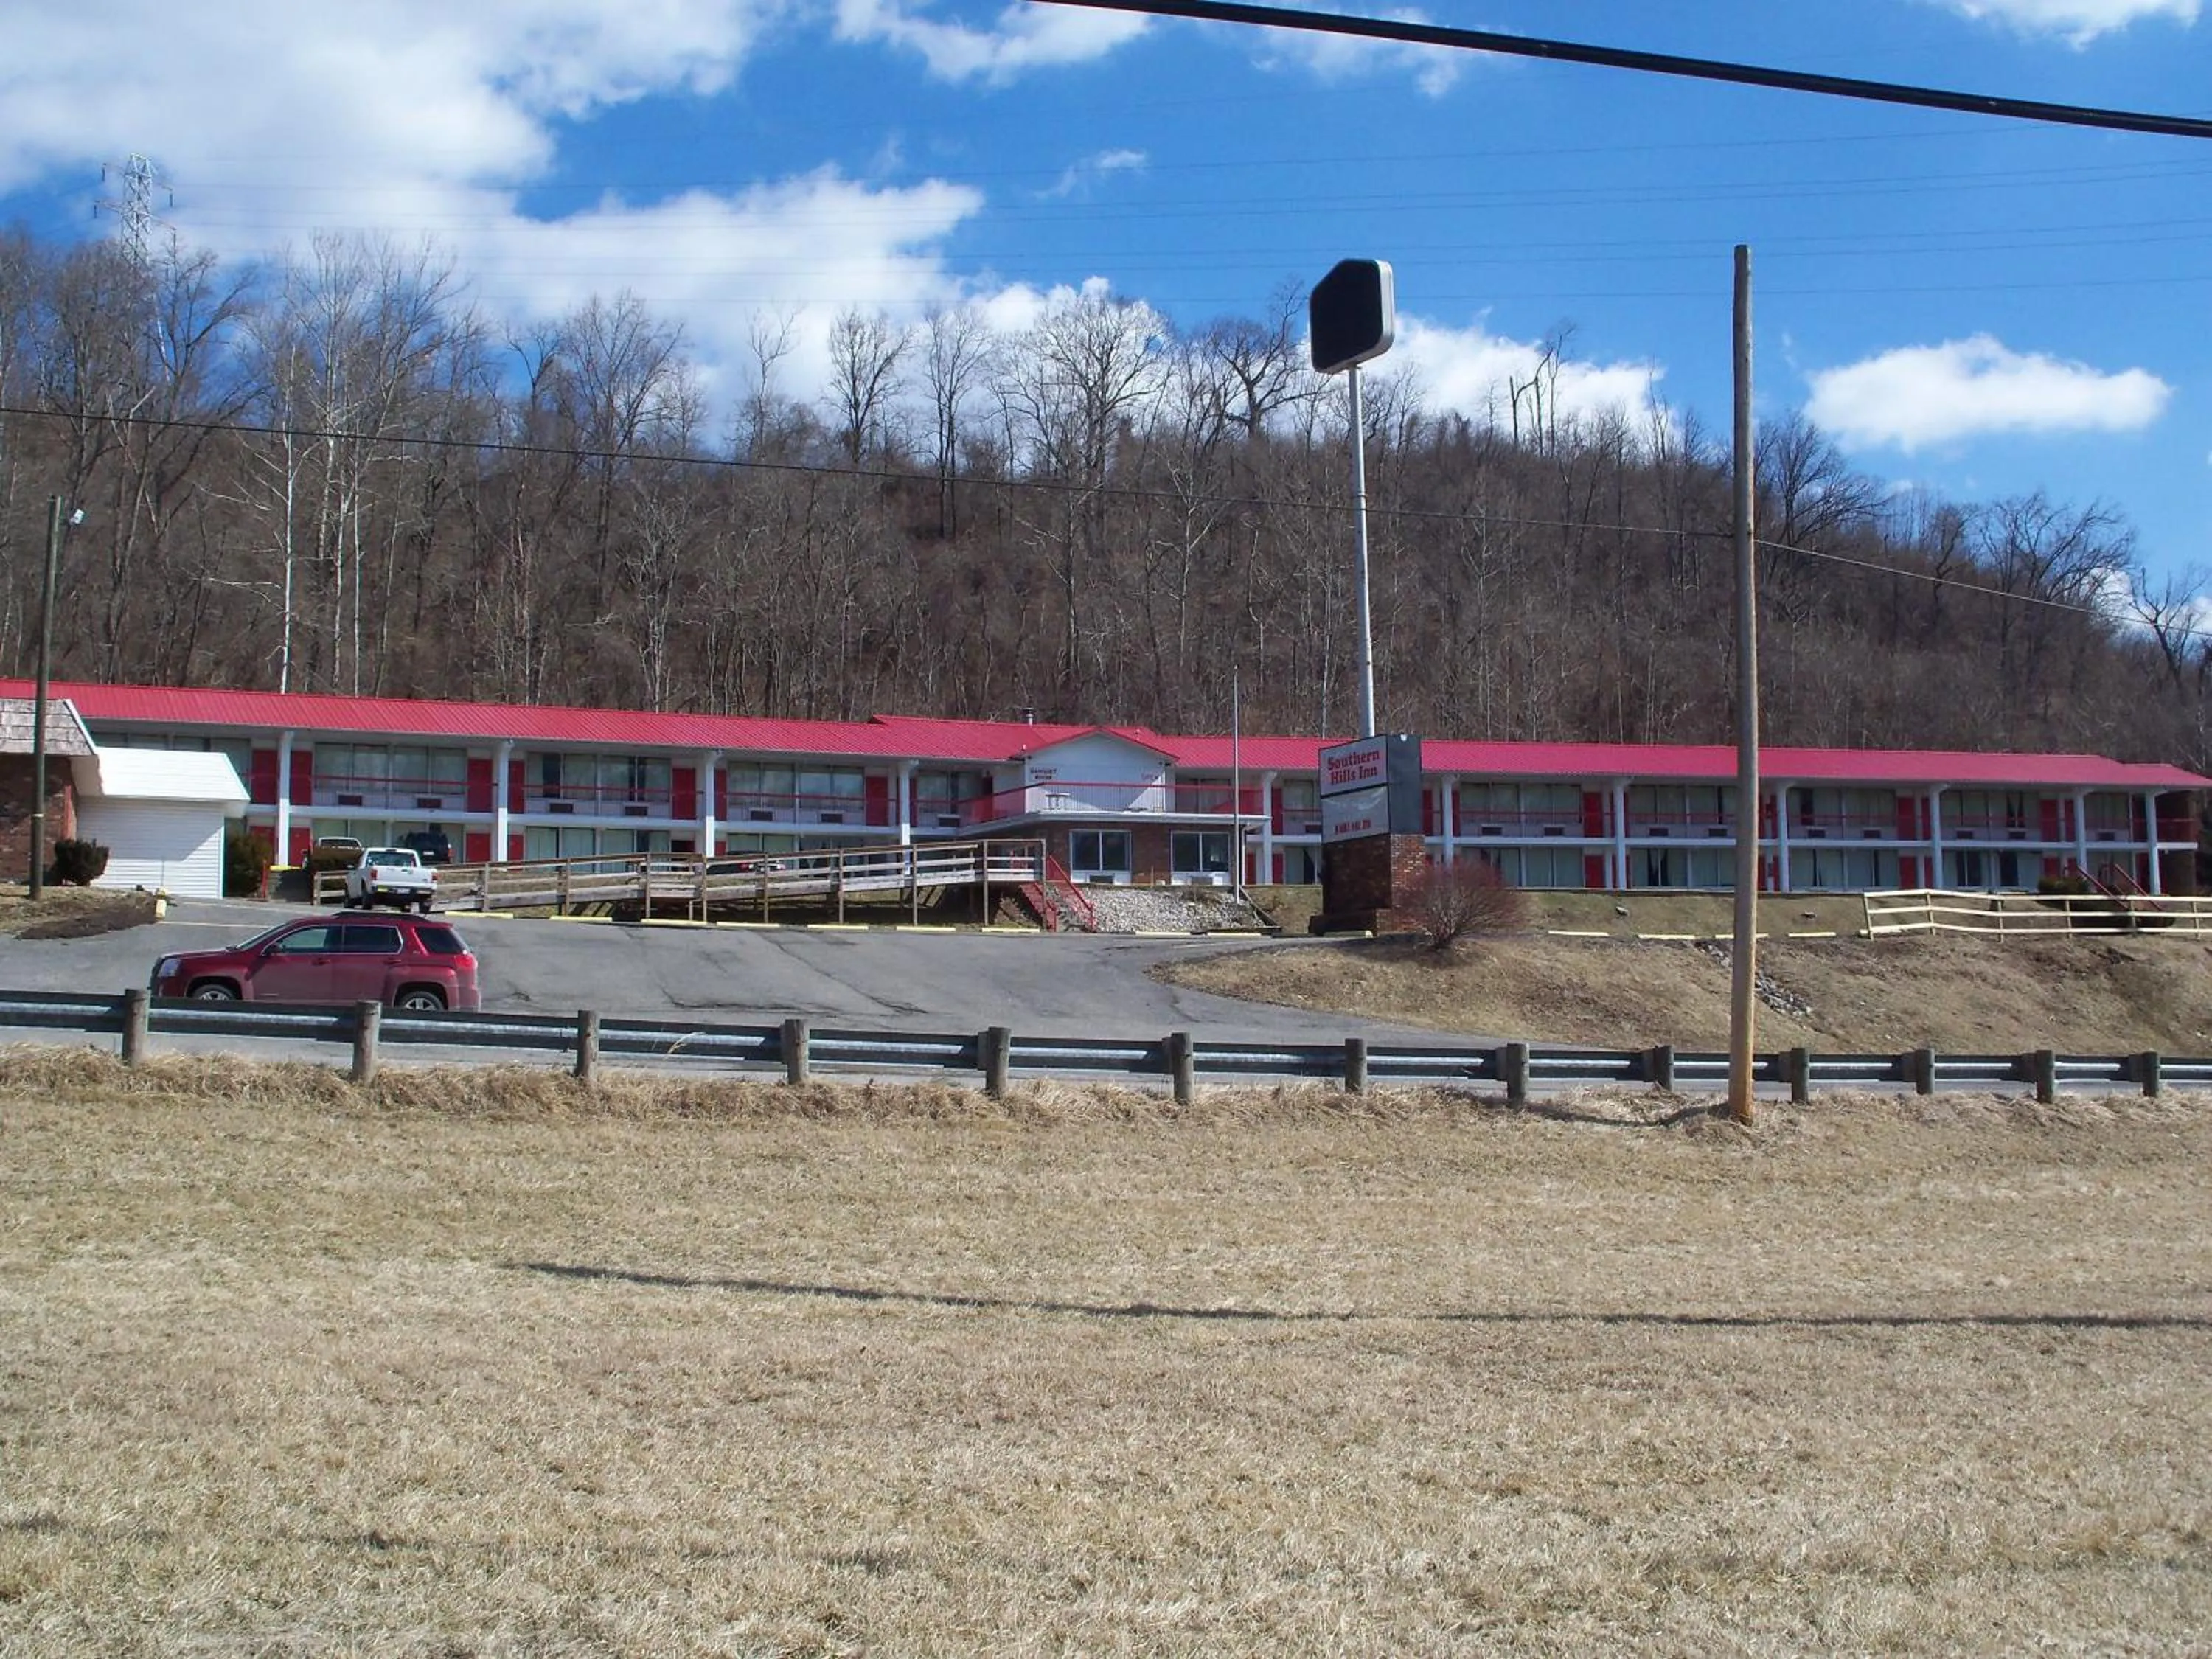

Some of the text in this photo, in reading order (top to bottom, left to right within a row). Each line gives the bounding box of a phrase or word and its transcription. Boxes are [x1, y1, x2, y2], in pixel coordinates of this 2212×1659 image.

[1328, 750, 1380, 771] Southern
[1330, 765, 1377, 785] Hills Inn
